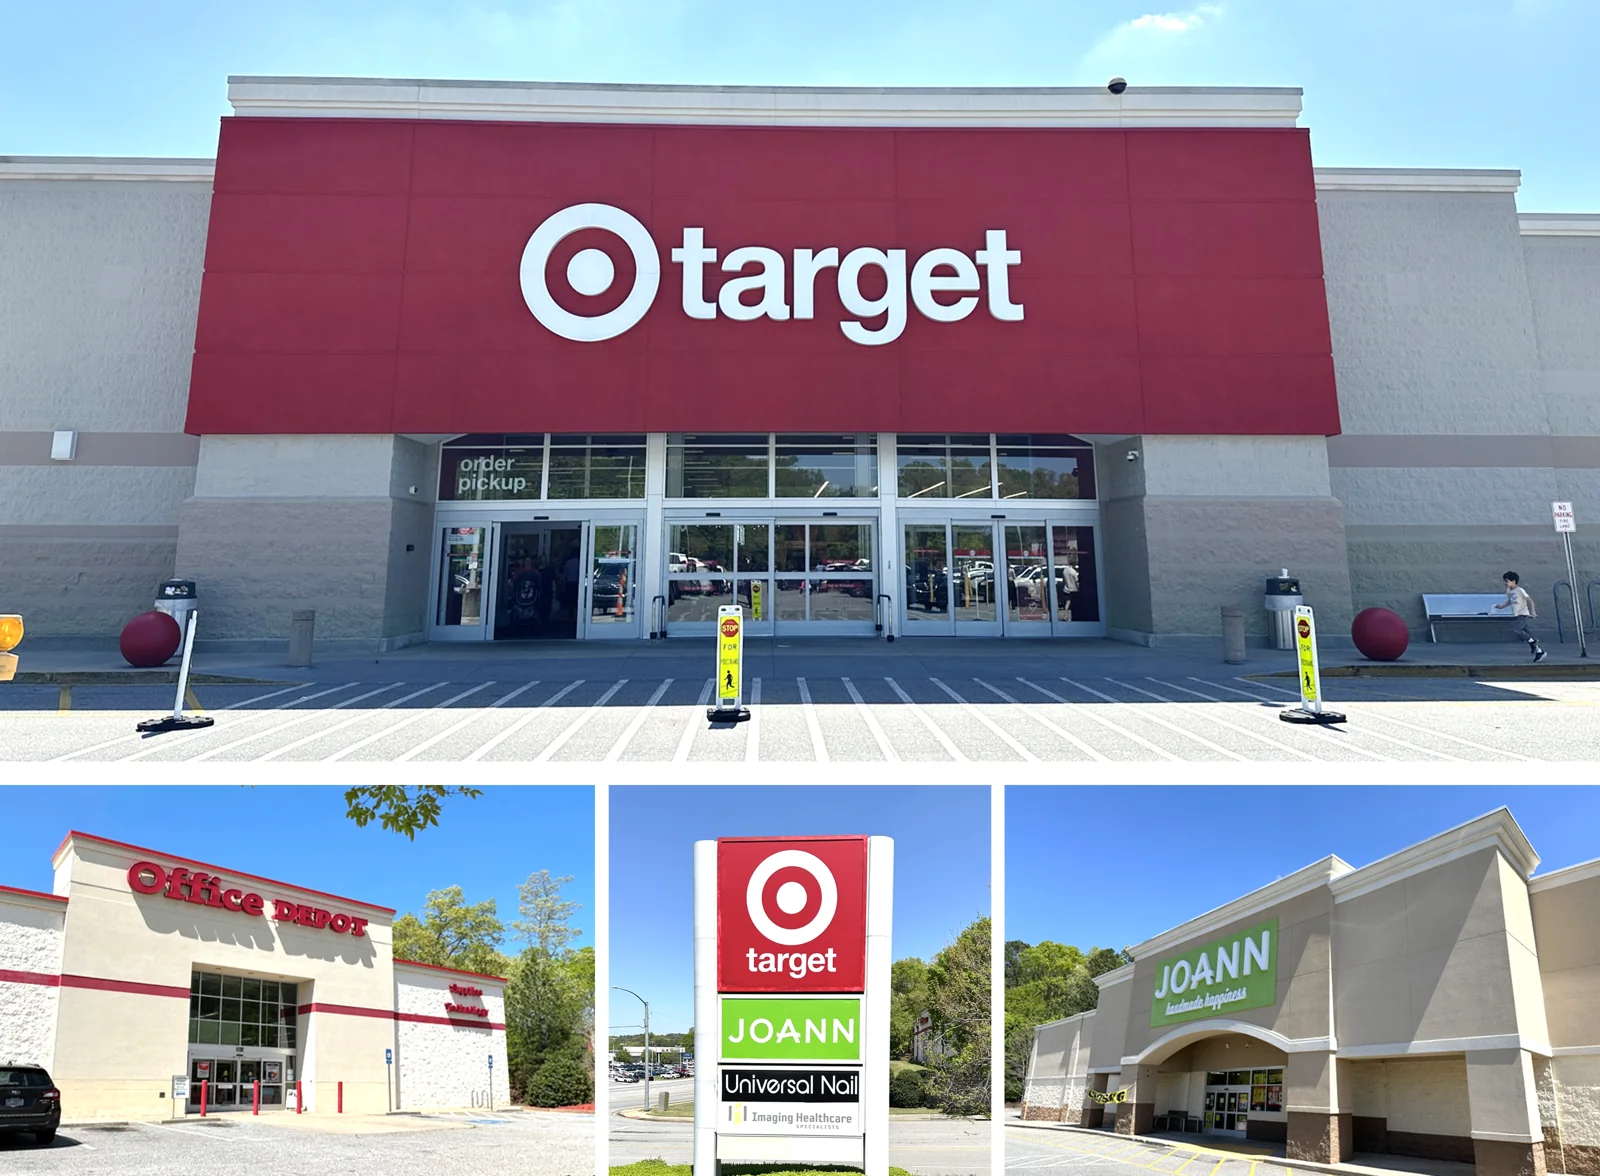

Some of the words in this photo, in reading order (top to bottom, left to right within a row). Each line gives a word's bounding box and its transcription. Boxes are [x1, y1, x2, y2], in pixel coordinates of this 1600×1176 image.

[672, 227, 1024, 345] target
[460, 455, 515, 471] order
[458, 473, 526, 494] pickup
[722, 624, 739, 632] STOP
[1298, 625, 1310, 633] STOP
[127, 861, 264, 916] Office
[272, 899, 368, 937] DEPOT
[746, 948, 837, 979] target
[1154, 930, 1270, 999] JOANN
[1165, 994, 1204, 1015] handmade
[1204, 986, 1247, 1011] happiness
[728, 1018, 855, 1043] JOANN
[725, 1074, 814, 1094] Universal
[821, 1075, 858, 1095] Nail
[752, 1112, 793, 1124] Imaging
[796, 1112, 852, 1123] Healthcare
